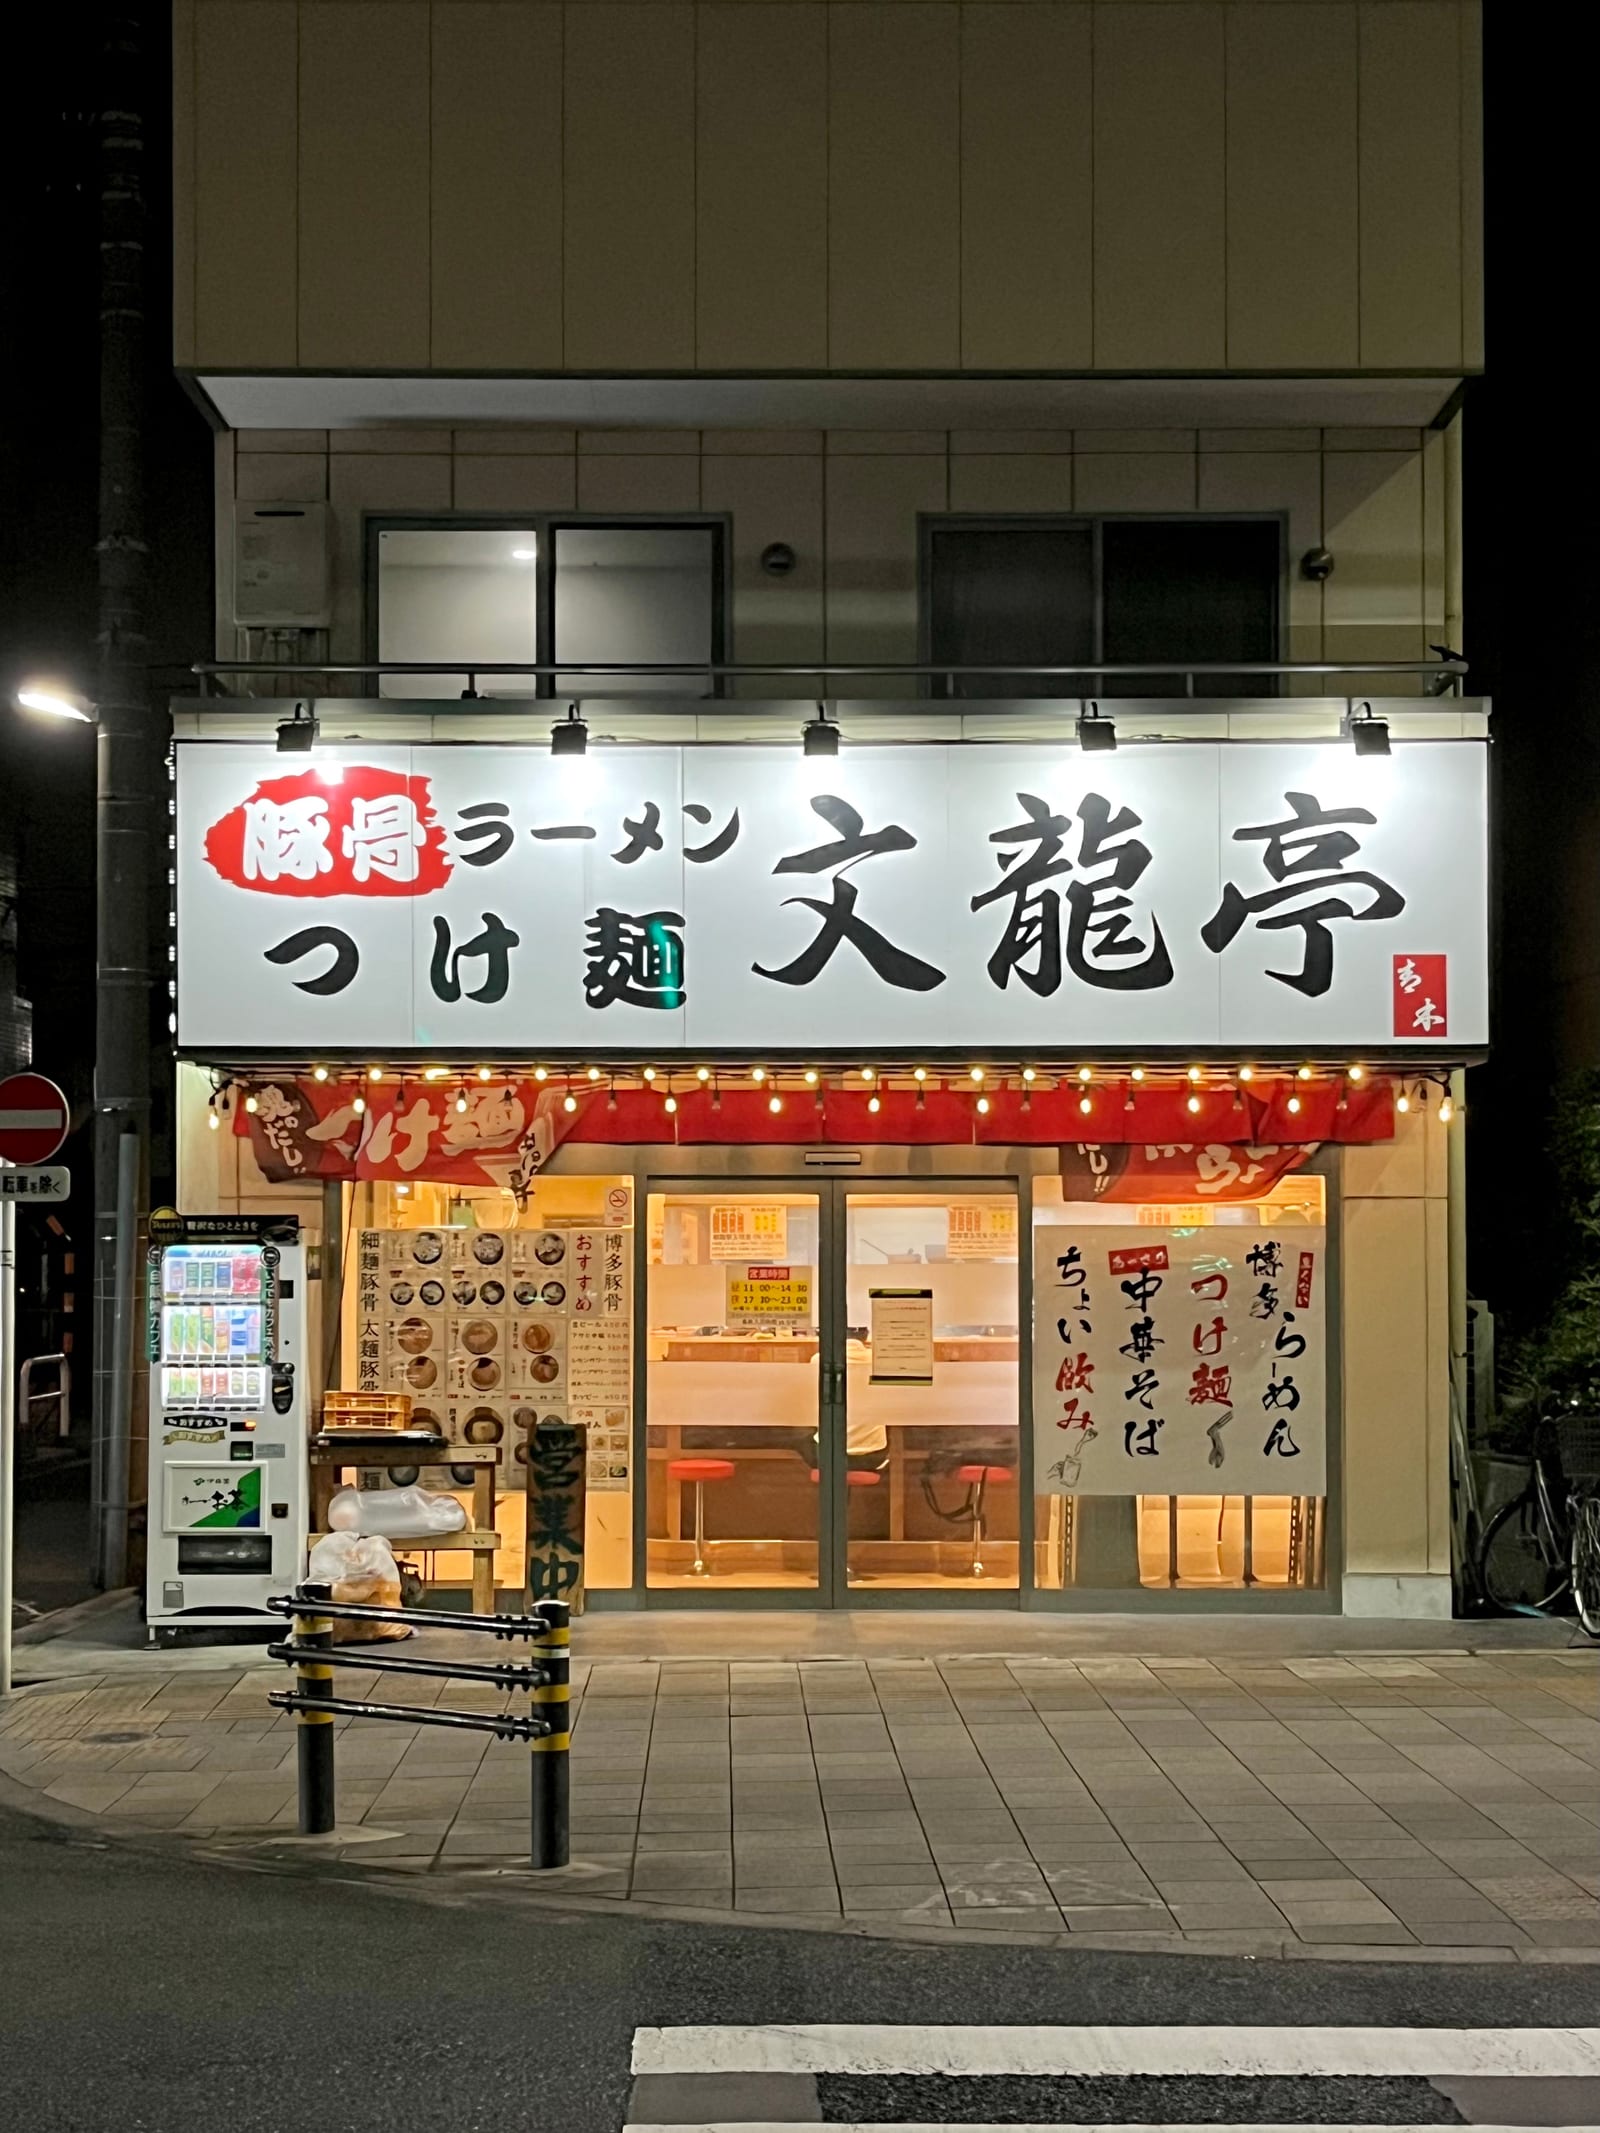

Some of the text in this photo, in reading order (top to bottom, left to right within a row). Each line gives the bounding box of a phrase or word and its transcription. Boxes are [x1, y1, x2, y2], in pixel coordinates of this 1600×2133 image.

[241, 795, 740, 882] 豚骨 ラーメン
[752, 792, 1406, 998] 文龍亭
[263, 907, 687, 1010] つけ麺
[360, 1231, 380, 1312] 細麺豚骨
[575, 1234, 593, 1312] おすすめ
[604, 1234, 624, 1312] 博多豚骨
[1053, 1246, 1095, 1430] ちょい飲み
[1119, 1267, 1165, 1457] 中華そば
[1186, 1273, 1233, 1408] つけ麺
